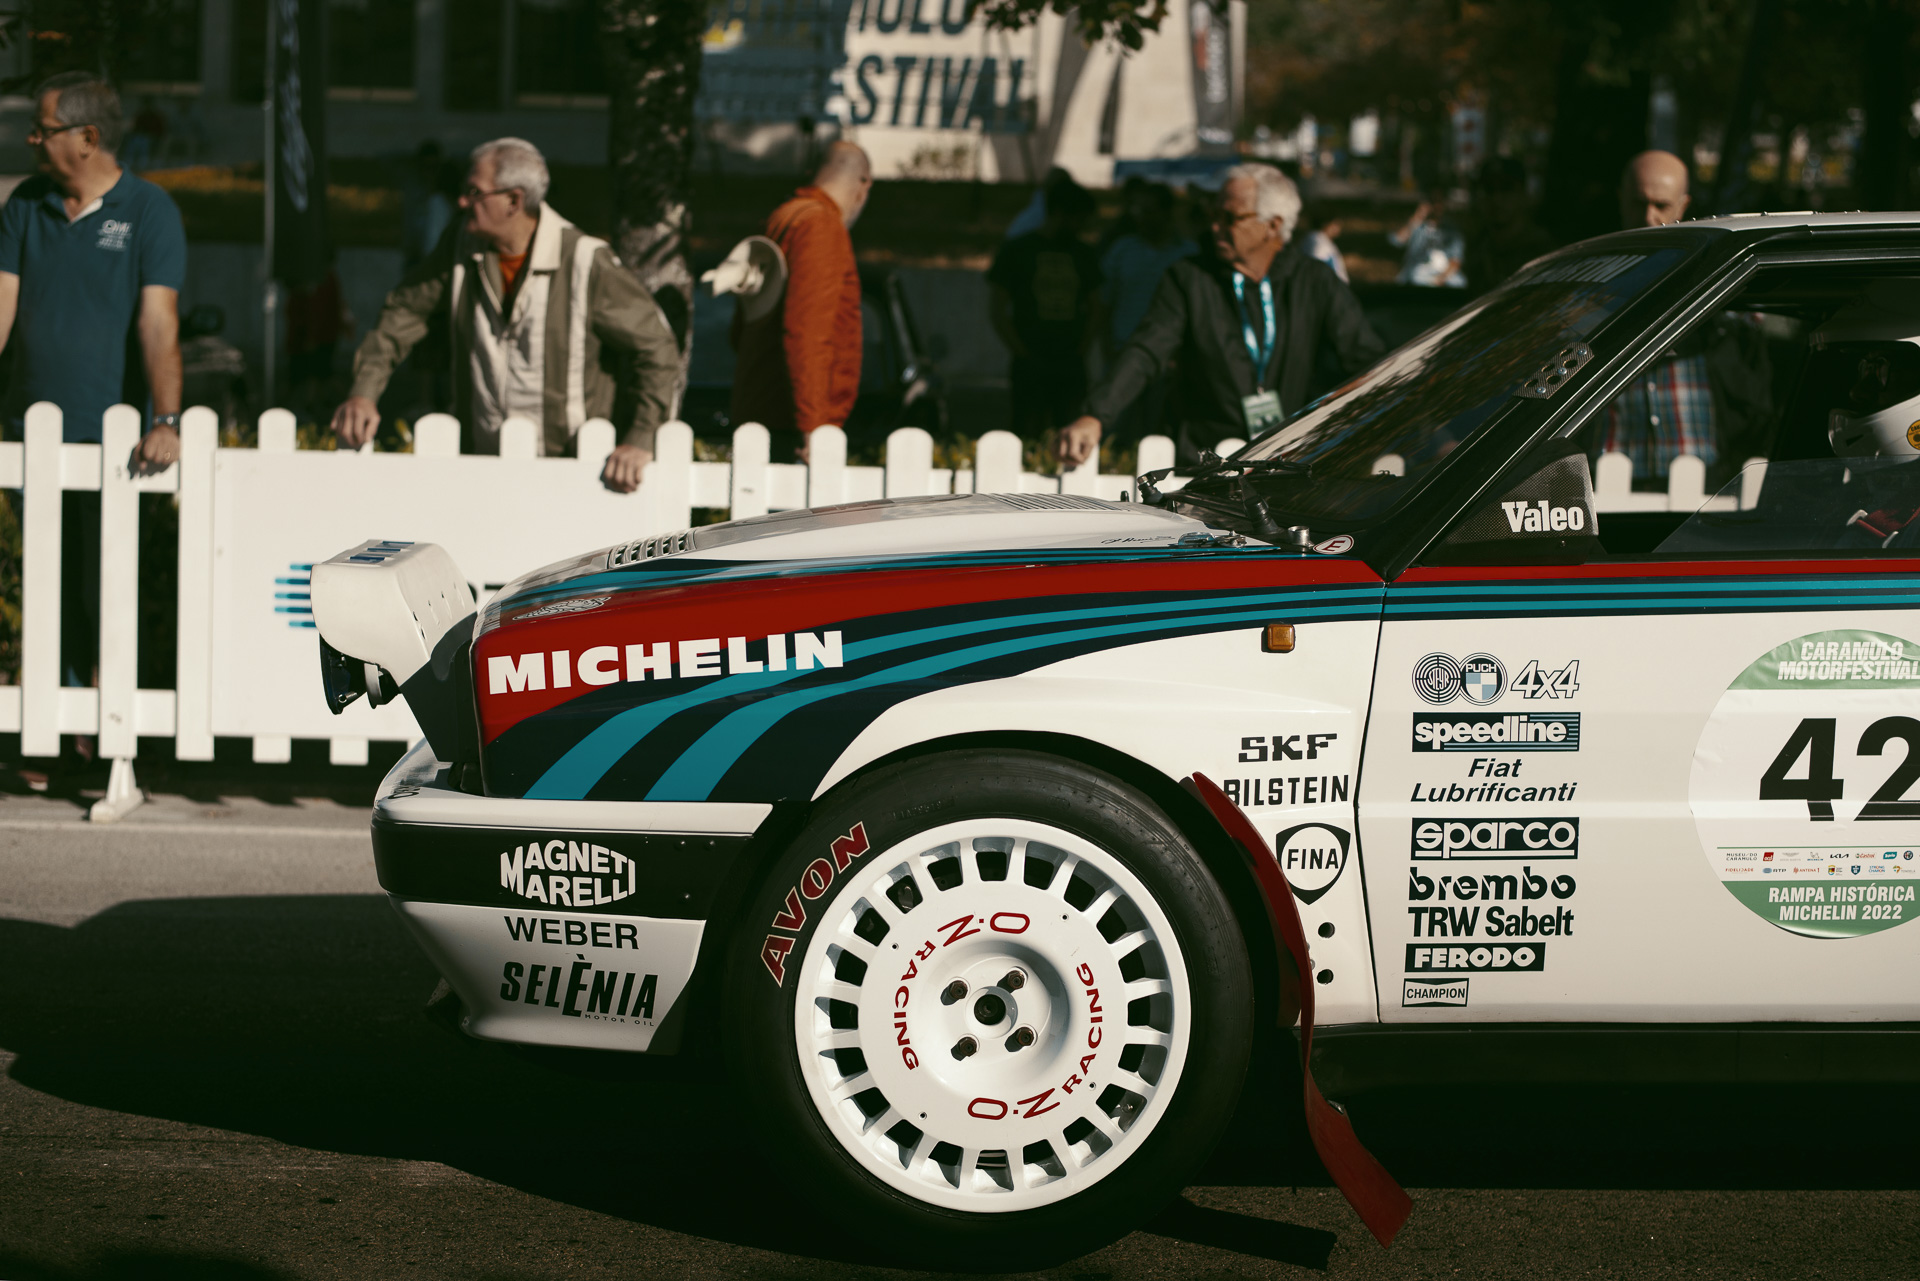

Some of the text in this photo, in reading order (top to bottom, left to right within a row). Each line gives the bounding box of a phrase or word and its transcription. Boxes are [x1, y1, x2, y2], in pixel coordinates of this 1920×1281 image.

[1502, 500, 1584, 533] Valeo
[488, 630, 844, 695] MICHELIN
[1800, 641, 1904, 661] CARAMULO
[1427, 660, 1580, 699] STEYR PUCH 4x4
[1778, 661, 1920, 681] MOTORFESTIVAL
[1238, 733, 1337, 763] SKF
[1415, 715, 1567, 750] speedline
[1468, 758, 1522, 778] Fiat
[1759, 716, 1920, 821] 42
[1224, 775, 1349, 806] BILSTEIN
[1410, 782, 1577, 803] Lubrificanti
[1415, 821, 1576, 859] sparco
[500, 839, 636, 896] MAGNETI
[1287, 848, 1339, 870] FINA
[500, 866, 636, 907] MARELLI
[1409, 866, 1576, 900] brembo
[1768, 883, 1915, 903] RAMPA HISTÓRICA
[760, 821, 870, 987] AVON
[1779, 905, 1902, 921] MICHELIN 2022
[504, 916, 639, 949] WEBER
[1408, 906, 1574, 937] TRW Sabelt
[1414, 947, 1536, 968] FERODO
[500, 954, 658, 1019] SELÈNIA
[1406, 988, 1466, 999] CHAMPION
[584, 1014, 626, 1024] MOTOR
[893, 940, 935, 1071] RACING
[1062, 962, 1104, 1094] RACING
